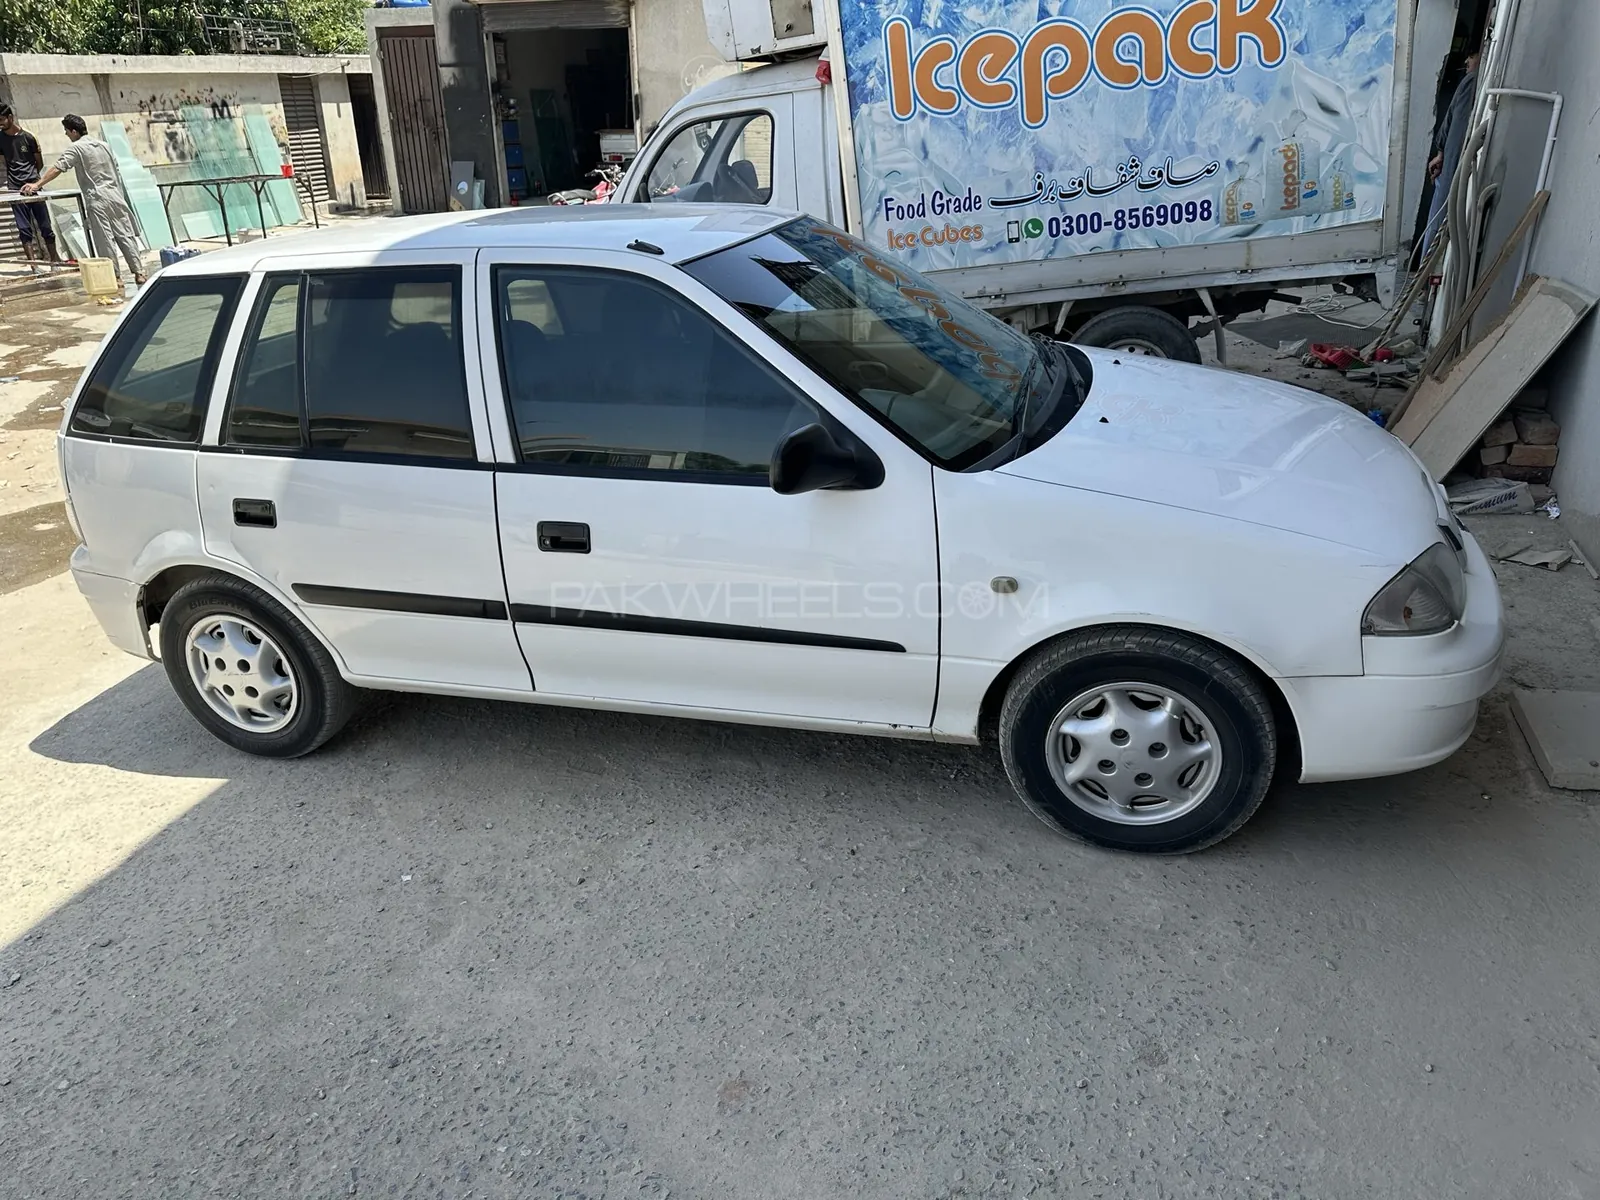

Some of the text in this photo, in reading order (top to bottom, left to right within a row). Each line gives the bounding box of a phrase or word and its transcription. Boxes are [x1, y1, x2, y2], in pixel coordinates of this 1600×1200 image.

[883, 0, 1287, 129] Icepack
[883, 186, 983, 222] Food Grade
[987, 171, 1058, 208] برف
[887, 223, 985, 251] Ice Cubes
[1048, 199, 1213, 239] 0300-8569098
